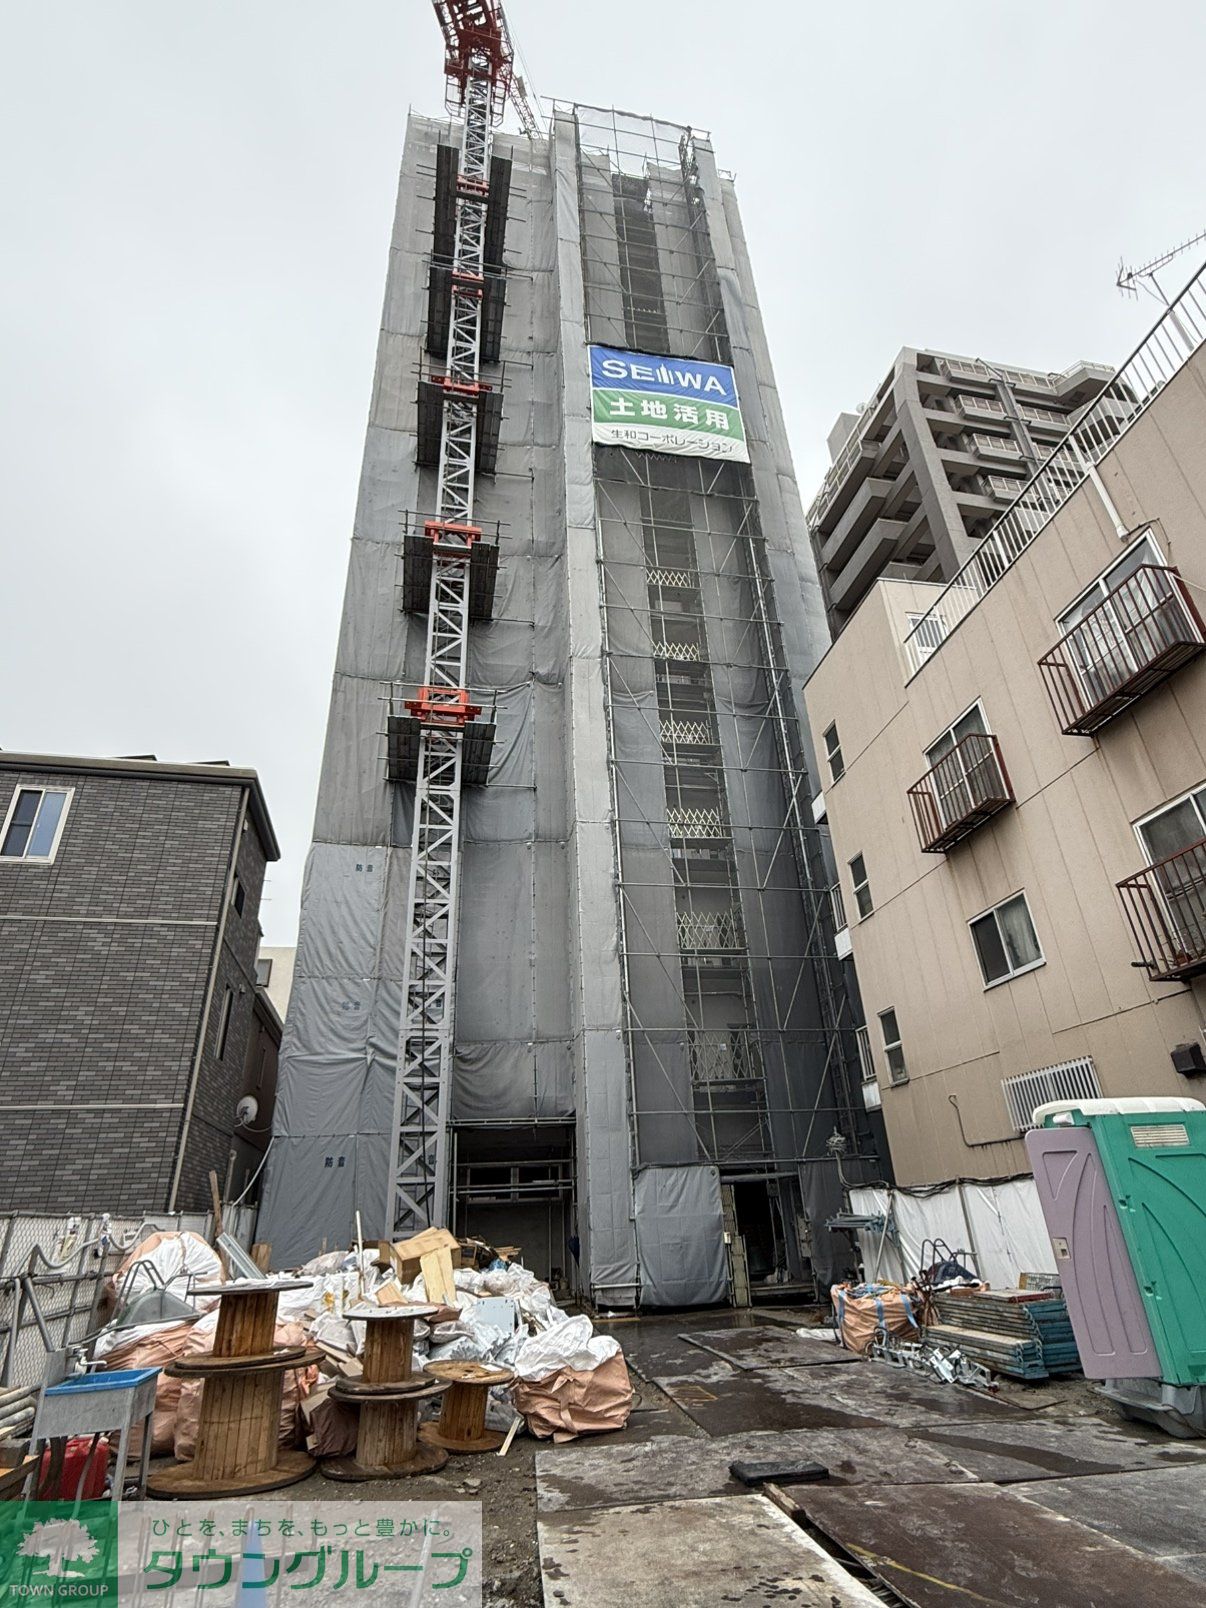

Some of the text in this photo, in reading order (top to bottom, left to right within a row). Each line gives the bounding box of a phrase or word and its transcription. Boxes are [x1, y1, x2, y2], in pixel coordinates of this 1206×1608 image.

[609, 397, 730, 431] 土地活用
[610, 429, 733, 453] 生和コーポレーション
